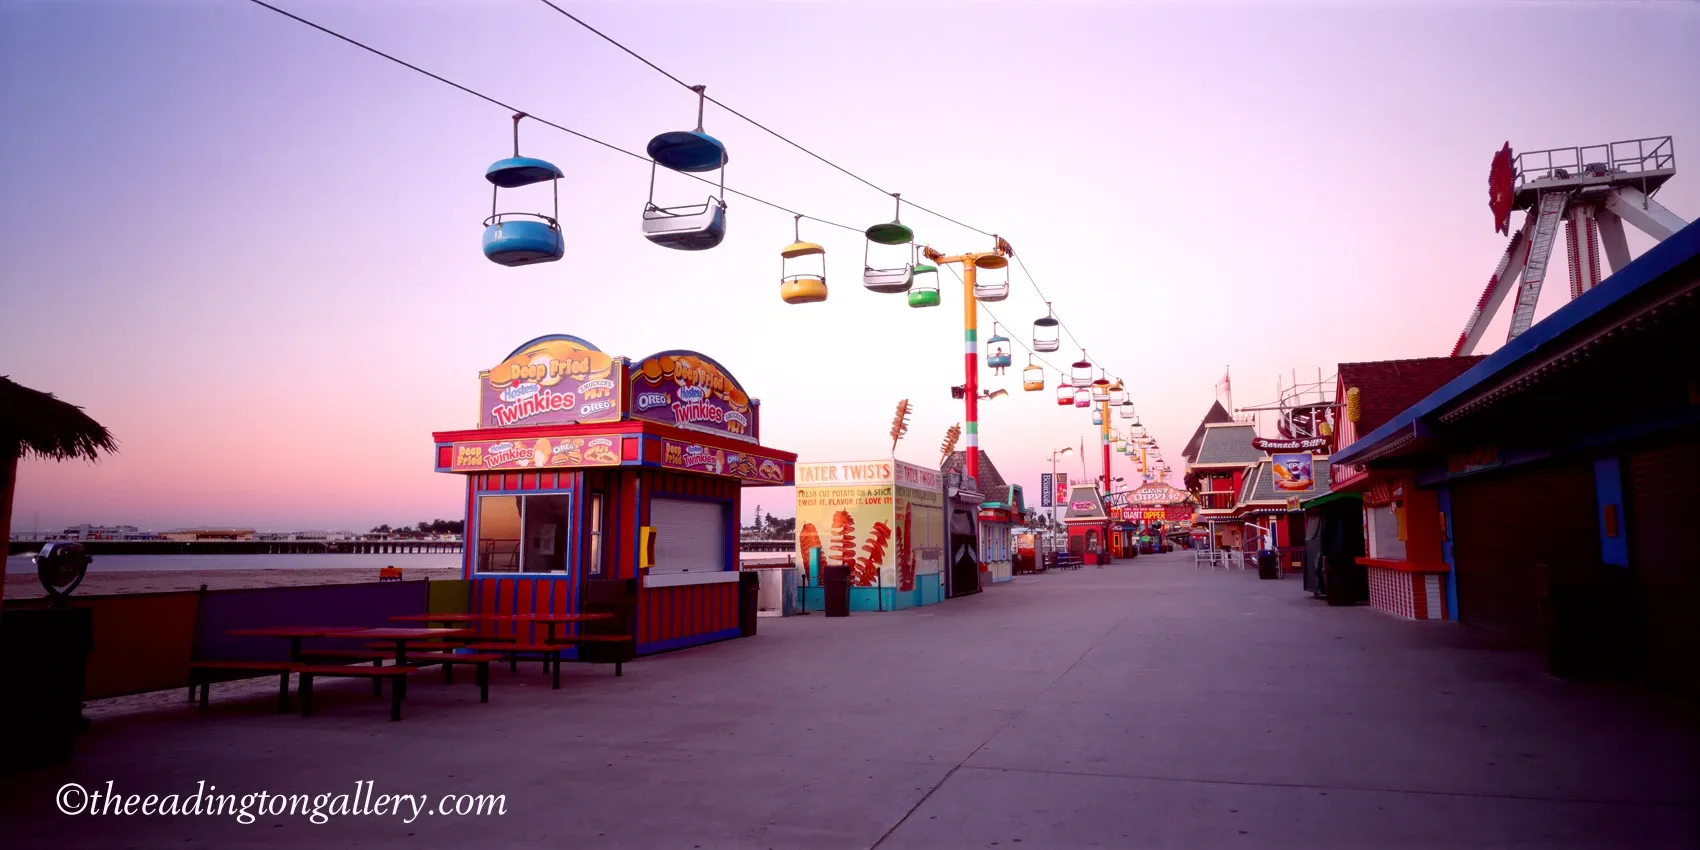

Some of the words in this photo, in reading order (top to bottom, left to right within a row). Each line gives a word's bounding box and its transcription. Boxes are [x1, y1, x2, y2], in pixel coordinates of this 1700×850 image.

[510, 363, 547, 380] Deep
[549, 356, 591, 377] Fried
[675, 360, 699, 386] Deep
[700, 368, 725, 393] Fried
[503, 383, 539, 401] Hostess
[680, 386, 703, 400] Hostess
[492, 389, 576, 426] Twinkies
[672, 398, 723, 424] Twinkies
[665, 442, 682, 454] Deep
[1259, 440, 1300, 449] Barnacle
[1301, 438, 1327, 448] Bill's
[459, 445, 482, 457] Deep
[457, 454, 483, 467] Fried
[483, 447, 534, 470] Twinkies
[665, 452, 683, 465] Fried
[683, 453, 717, 468] Twinkies
[799, 465, 838, 482] TATER
[842, 464, 891, 480] TWISTS
[798, 489, 817, 498] FRESH
[819, 489, 830, 498] CUT
[832, 489, 855, 498] POTATO
[867, 488, 873, 496] A
[873, 487, 892, 496] STICK
[1134, 493, 1179, 501] DIPPER
[798, 499, 817, 507] TWIST
[828, 498, 853, 506] FLAVOR
[865, 497, 882, 505] LOVE
[1123, 511, 1143, 519] GIANT
[1143, 511, 1165, 519] DIPPER
